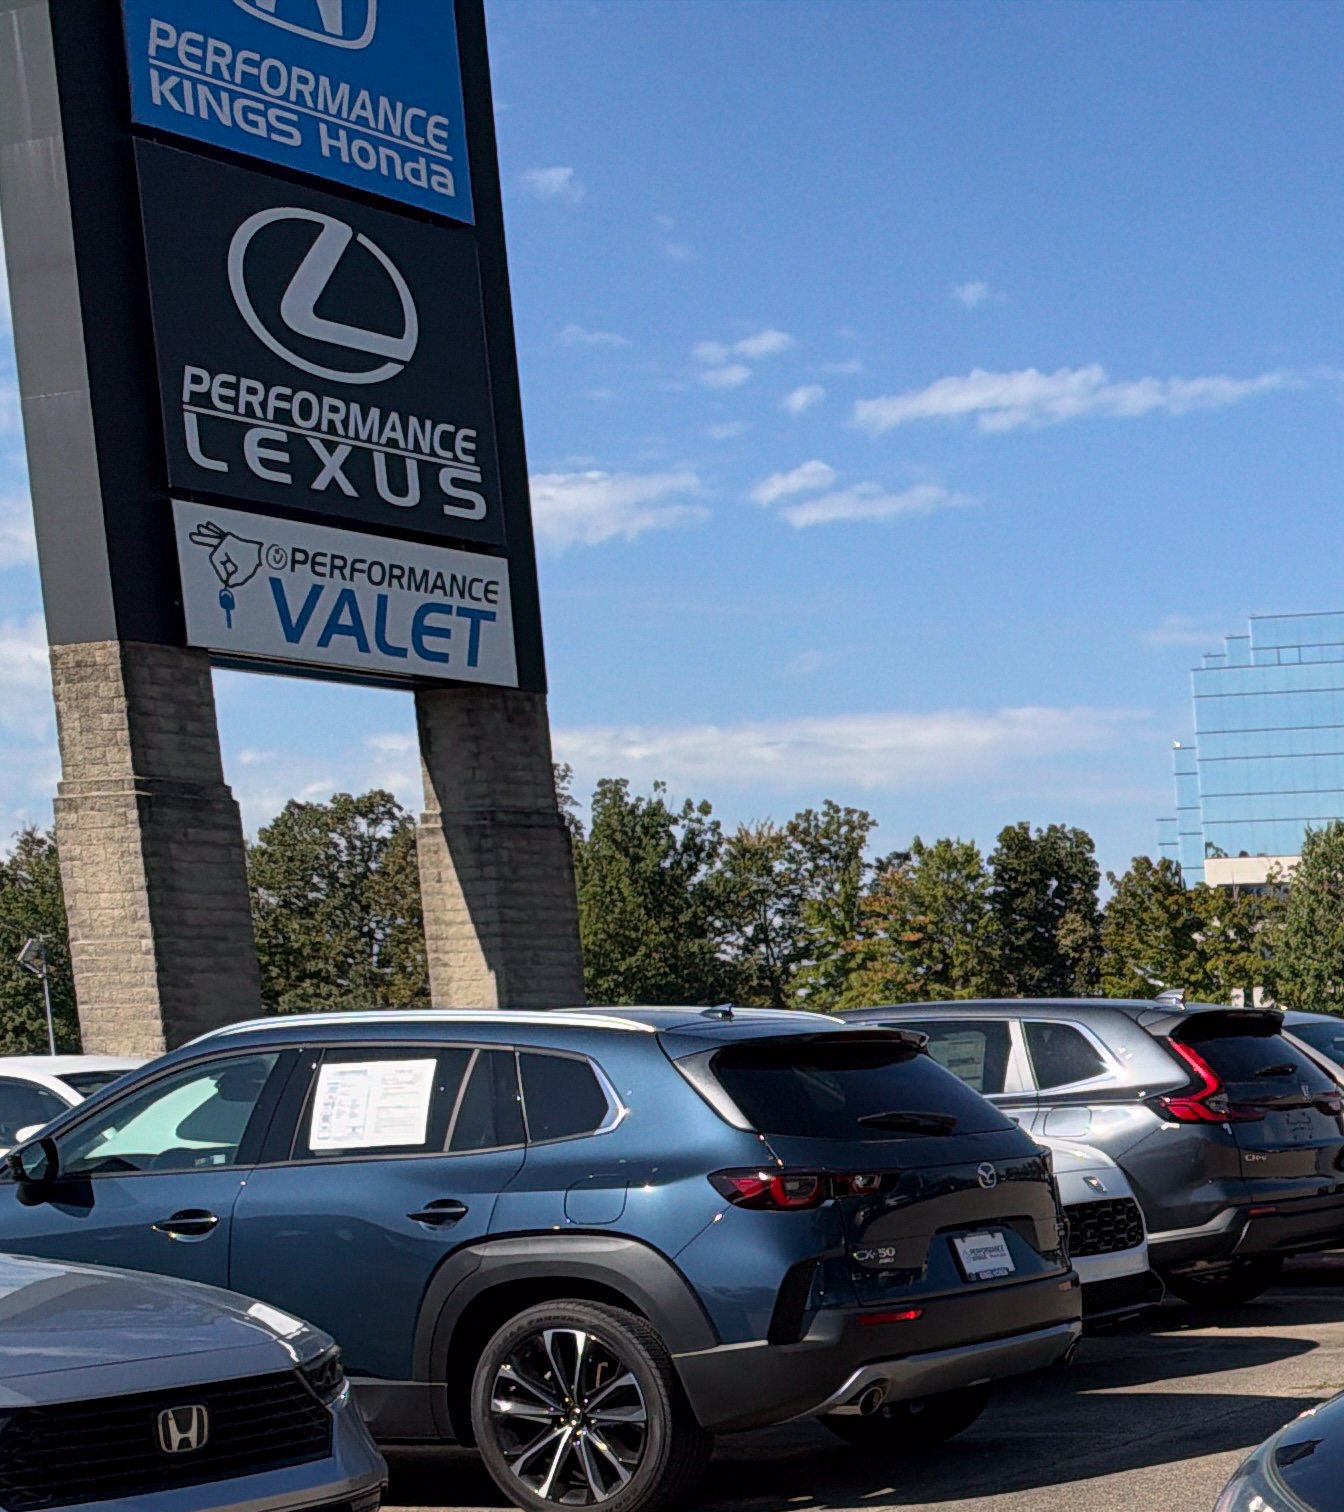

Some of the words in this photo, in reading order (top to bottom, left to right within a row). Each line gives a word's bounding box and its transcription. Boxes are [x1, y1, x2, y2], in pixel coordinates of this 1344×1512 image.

[148, 17, 450, 152] PERFORMANCE
[149, 67, 302, 147] KINGS
[319, 121, 456, 198] Honda
[182, 364, 478, 464] PERFORMANCE
[183, 410, 488, 521] LEXUS
[268, 576, 497, 668] VALET
[290, 546, 500, 605] PERFORMANCE
[852, 1246, 896, 1262] CX-50
